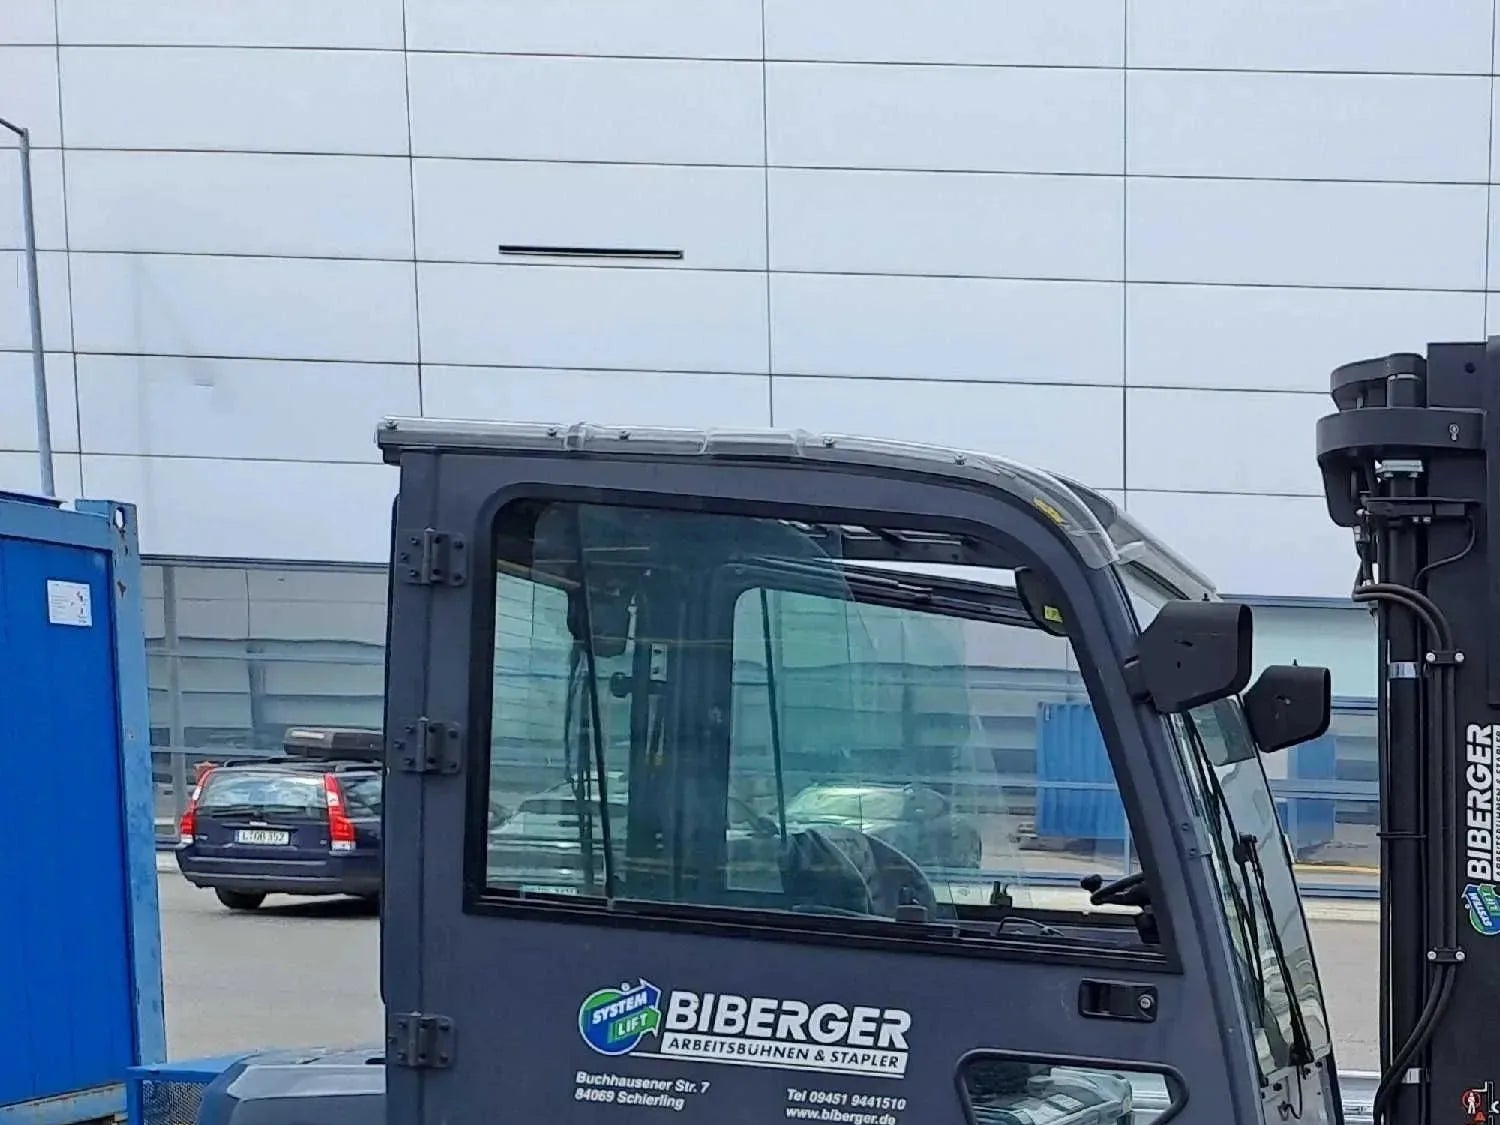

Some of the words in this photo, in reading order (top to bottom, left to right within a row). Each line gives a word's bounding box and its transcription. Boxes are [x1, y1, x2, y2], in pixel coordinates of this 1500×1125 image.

[1466, 723, 1492, 880] BIBERGER
[591, 991, 648, 1025] SYSTEM
[665, 990, 912, 1049] BIBERGER
[617, 1013, 649, 1037] LIFT
[668, 1037, 809, 1061] ARBEITSBÜHNEN
[814, 1049, 826, 1062] &
[830, 1050, 899, 1069] STAPLER
[576, 1071, 673, 1091] Buchhausener
[674, 1079, 698, 1093] Str.
[700, 1081, 710, 1094] 7
[575, 1087, 615, 1103] 84069
[617, 1090, 685, 1111] Schierling
[786, 1088, 806, 1102] Tel
[809, 1090, 848, 1106] 09451
[850, 1094, 907, 1110] 9441510
[786, 1107, 897, 1125] www.biberger.de
